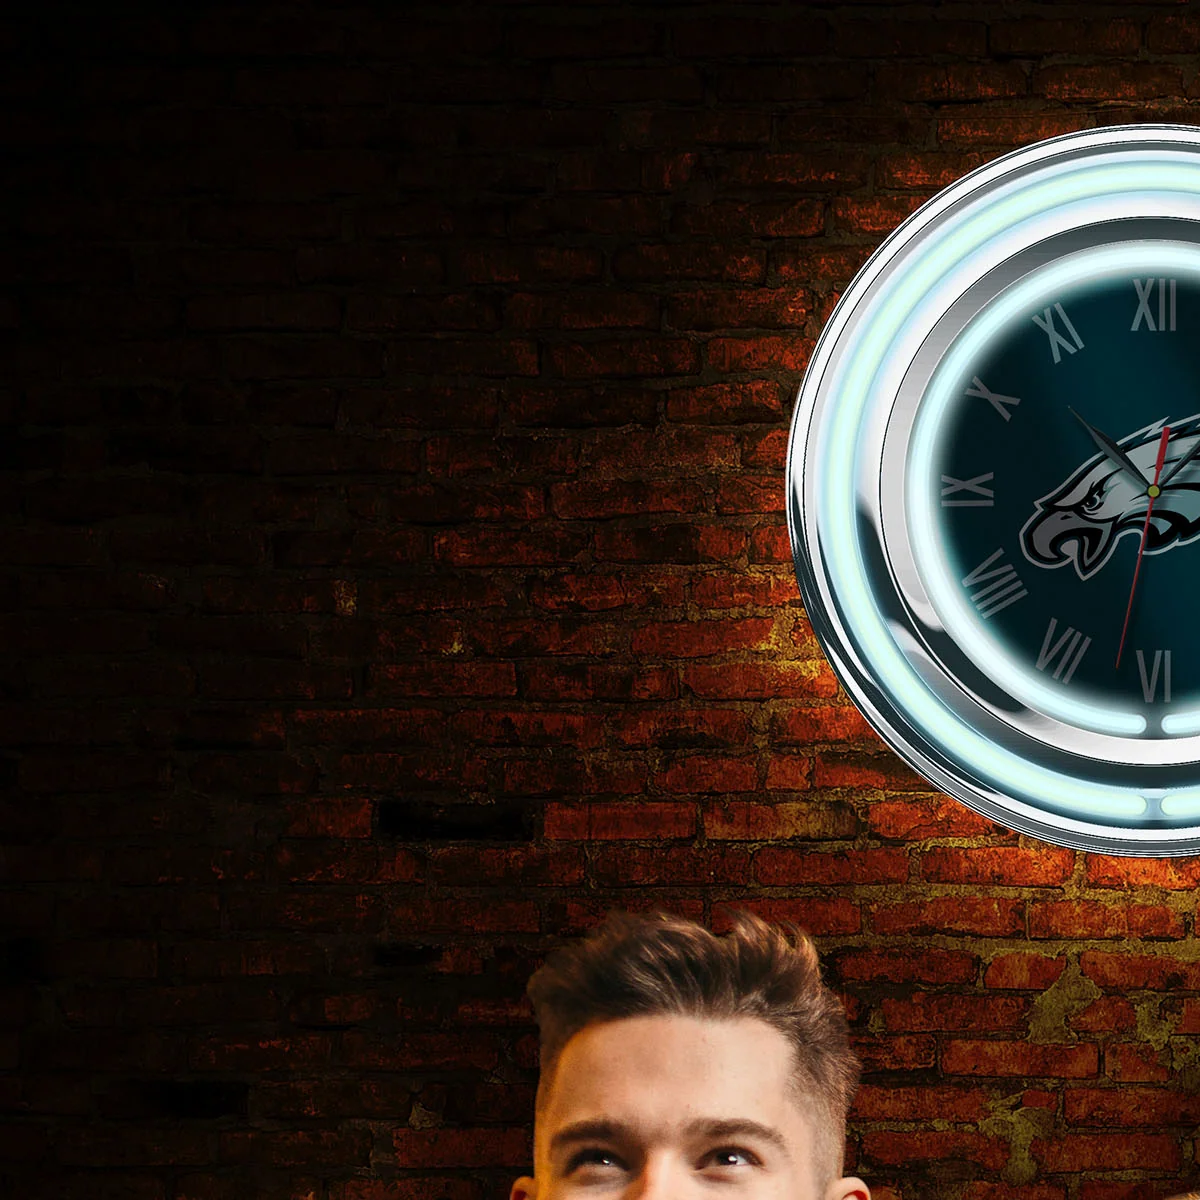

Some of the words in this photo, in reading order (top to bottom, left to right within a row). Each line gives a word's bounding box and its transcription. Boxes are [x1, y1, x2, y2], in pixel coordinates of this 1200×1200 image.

[1130, 278, 1177, 332] XII
[1031, 302, 1085, 364] XI
[964, 376, 1021, 422] X
[941, 472, 994, 507] IX
[962, 547, 1028, 619] VIII
[1035, 617, 1092, 684] VII
[1136, 649, 1171, 703] VI
